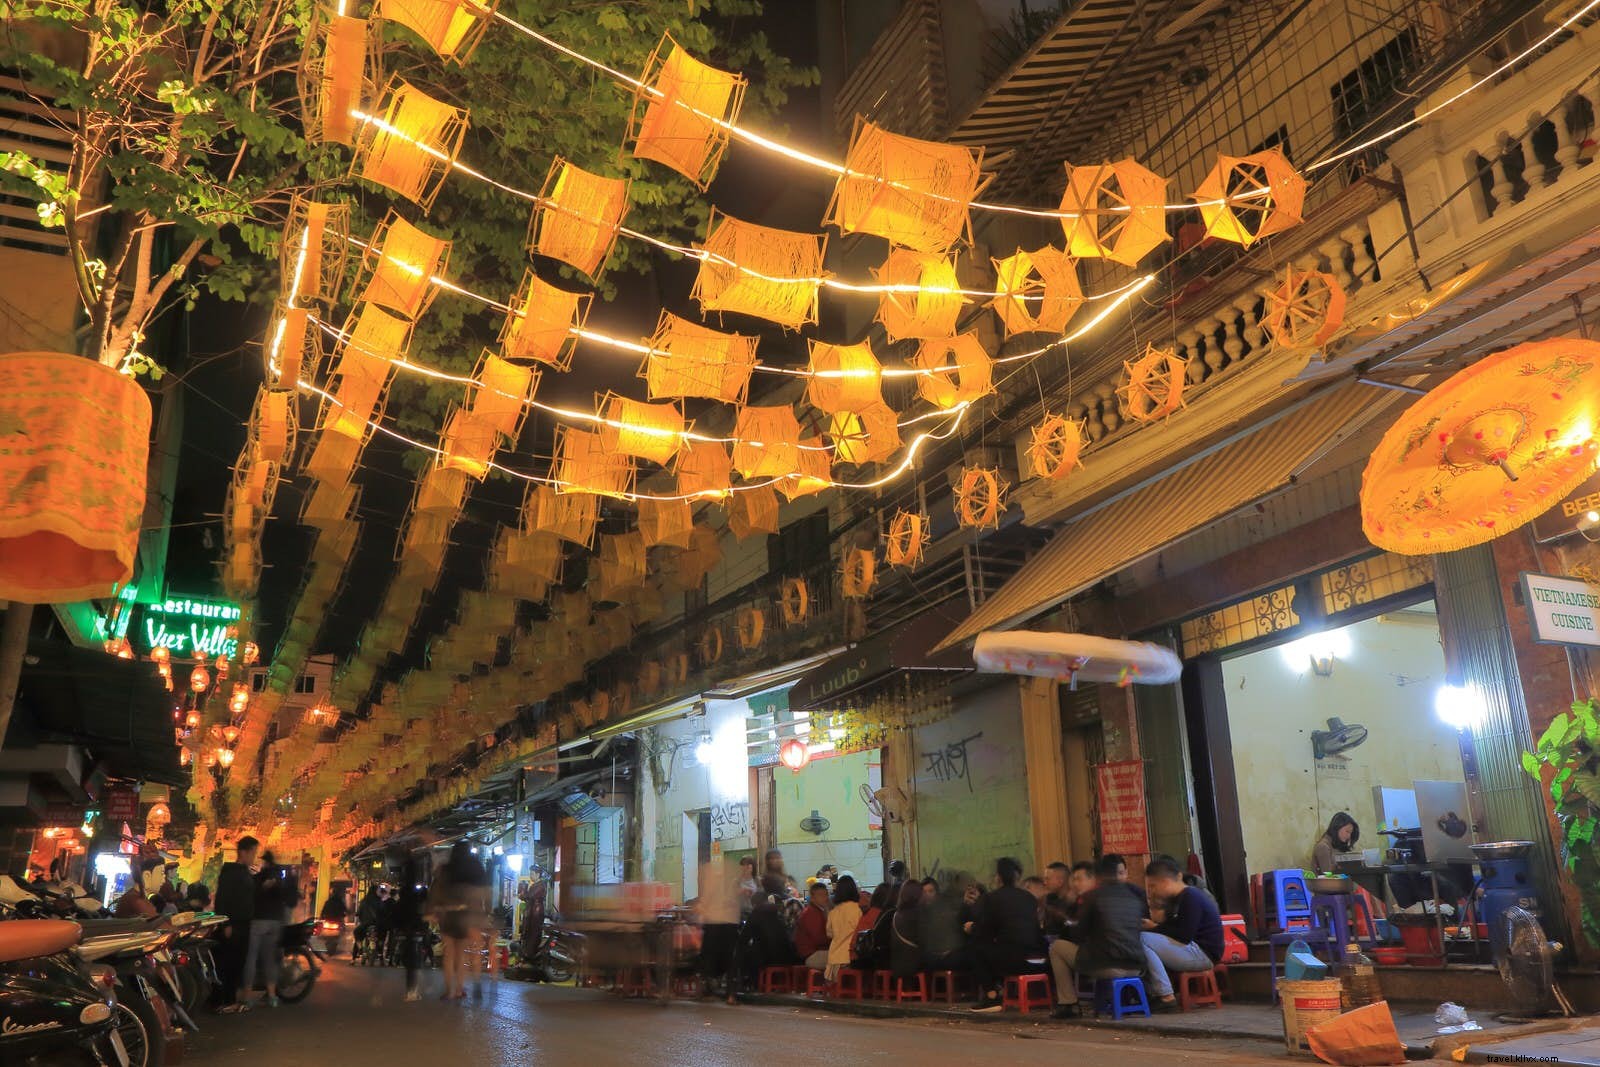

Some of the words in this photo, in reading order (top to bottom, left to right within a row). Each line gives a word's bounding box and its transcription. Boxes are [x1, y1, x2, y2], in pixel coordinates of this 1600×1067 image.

[1562, 492, 1600, 518] BEE
[1532, 587, 1600, 609] VIETNAMESE
[150, 600, 241, 620] estauran
[1551, 612, 1594, 631] CUISINE
